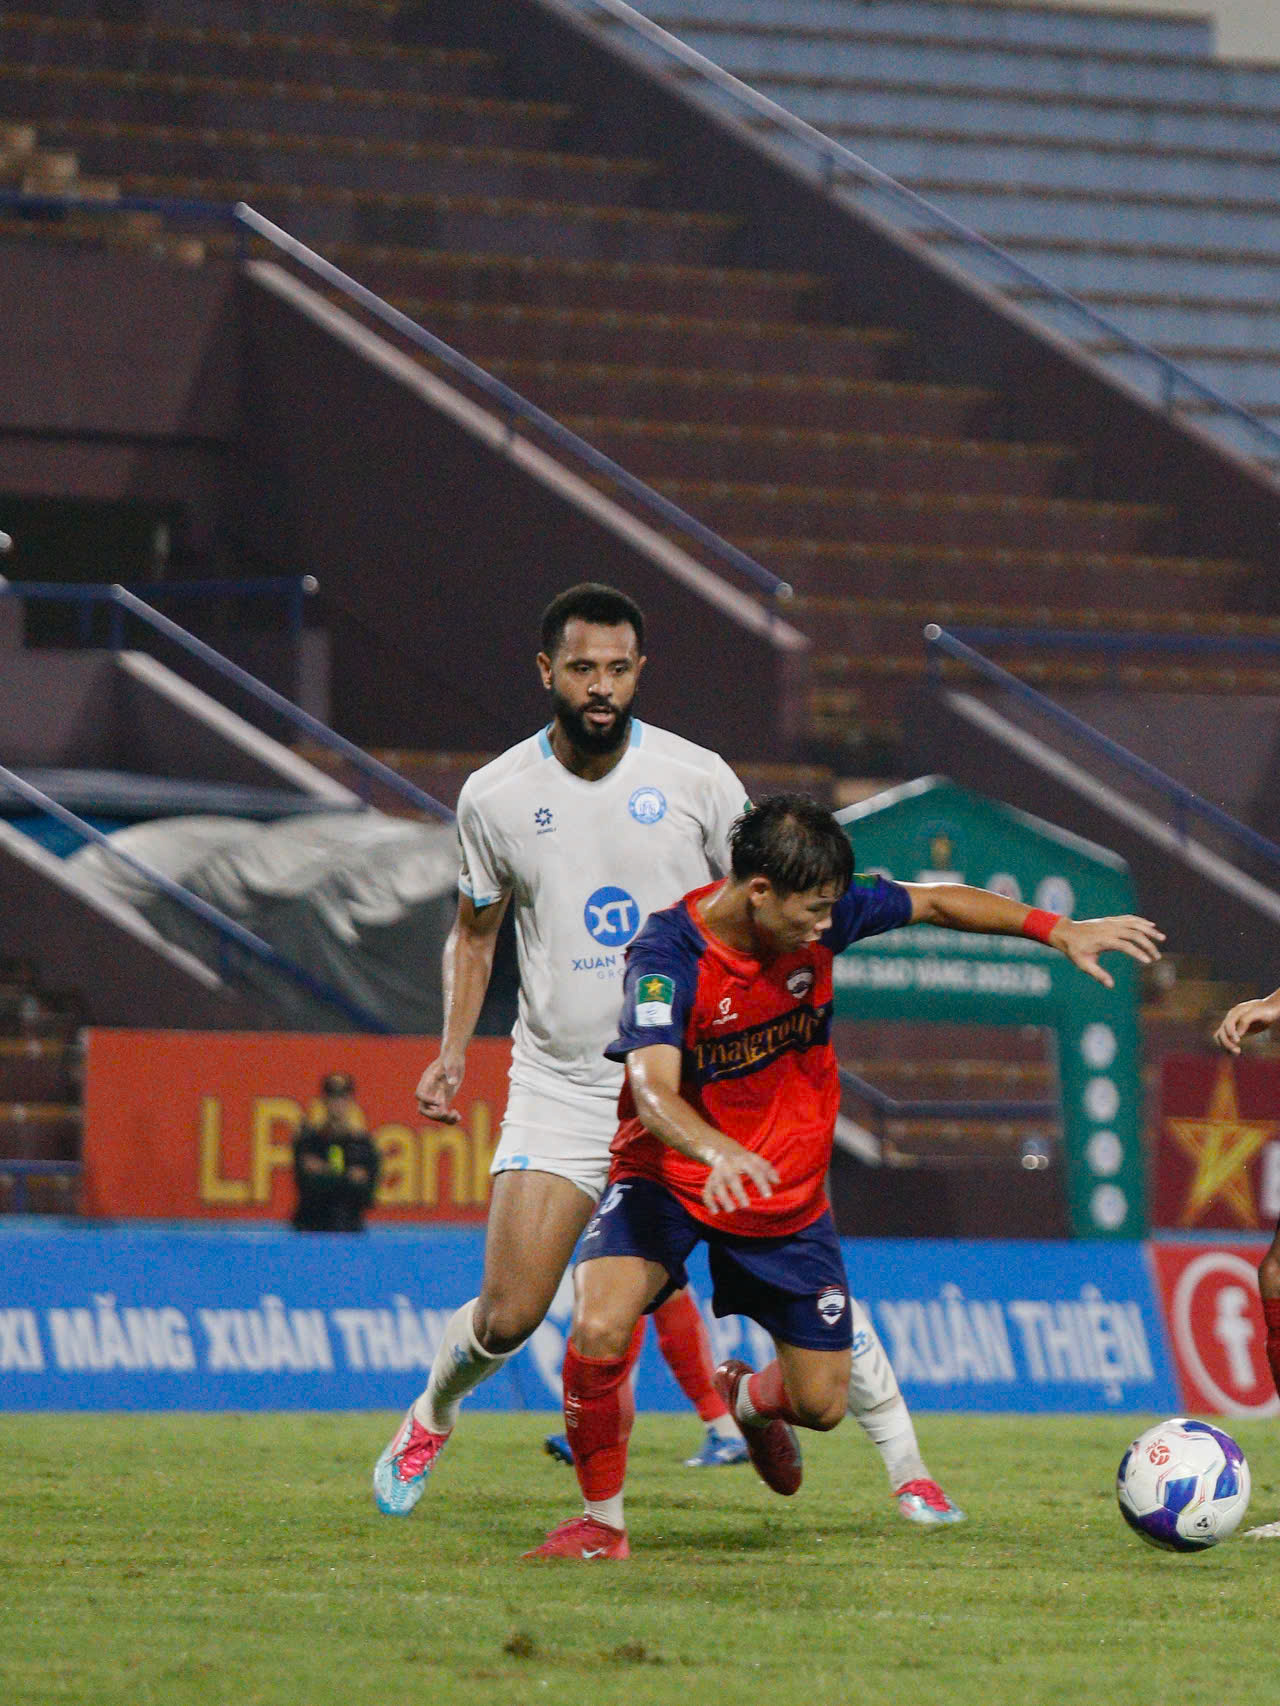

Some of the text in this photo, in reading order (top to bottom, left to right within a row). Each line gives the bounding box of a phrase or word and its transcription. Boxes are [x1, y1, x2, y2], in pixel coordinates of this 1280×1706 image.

[572, 955, 616, 971] XUAN
[202, 1096, 502, 1204] LPank
[198, 1294, 334, 1373] XUÂN
[331, 1294, 457, 1373] THÀN
[876, 1283, 1017, 1381] XUÂN
[1007, 1282, 1155, 1405] THIỆN
